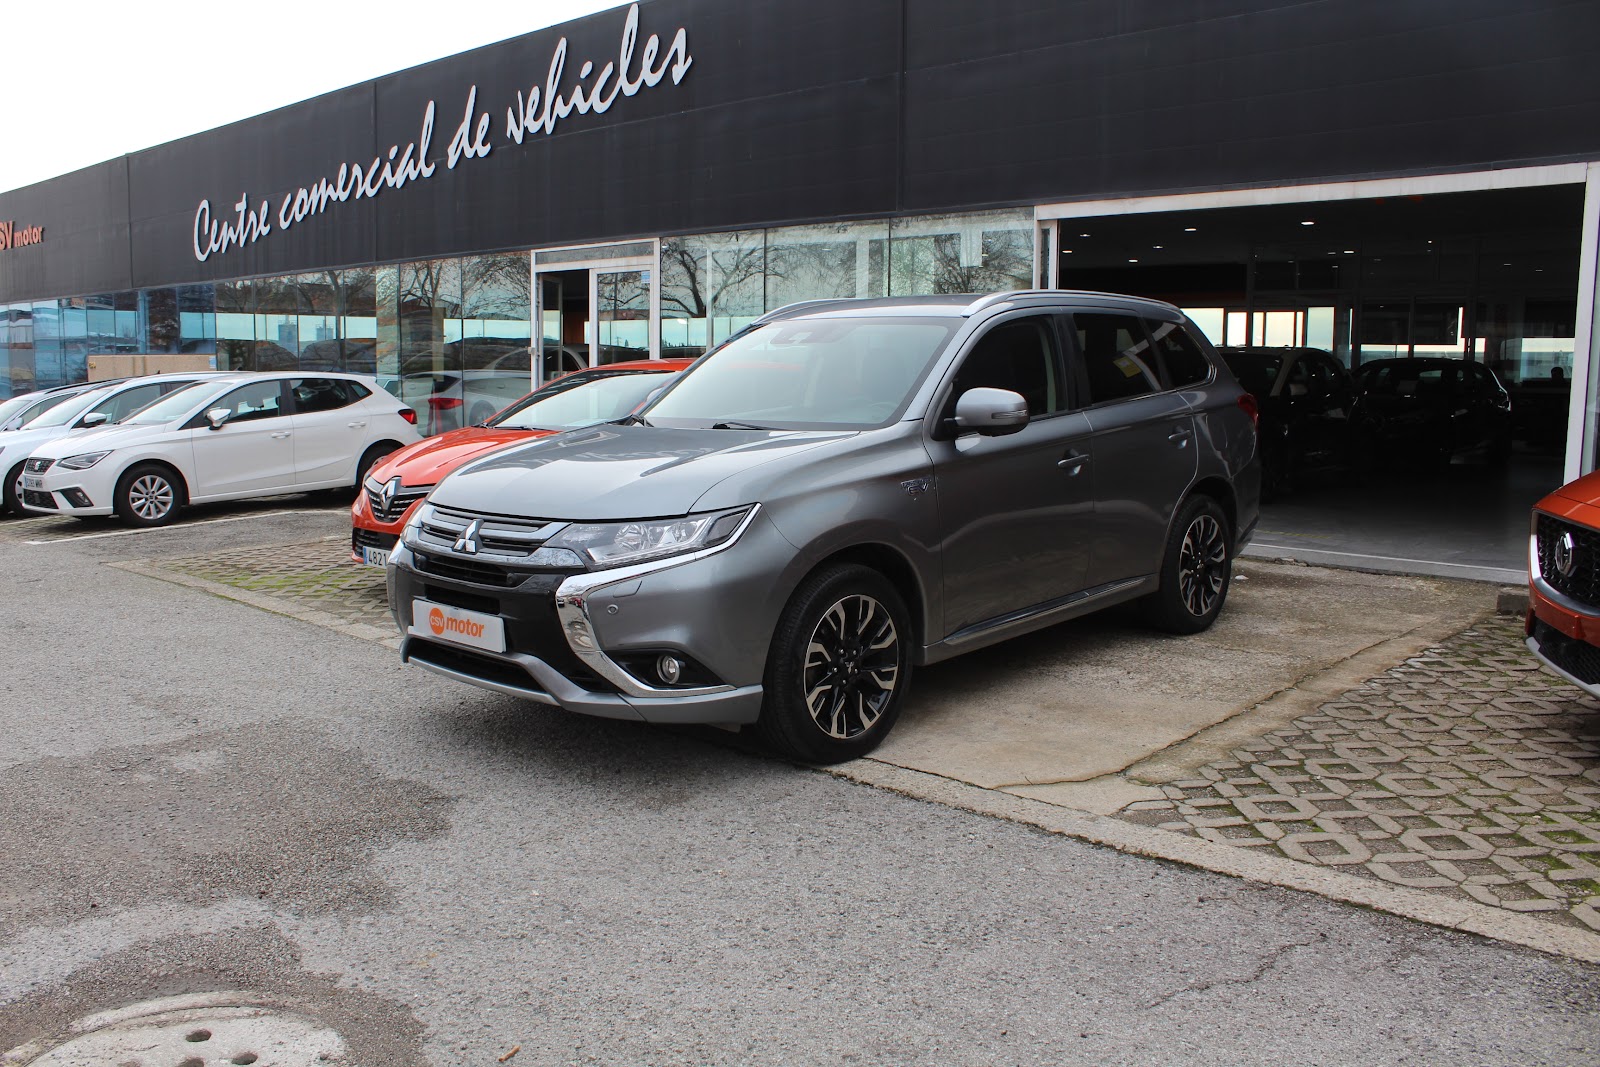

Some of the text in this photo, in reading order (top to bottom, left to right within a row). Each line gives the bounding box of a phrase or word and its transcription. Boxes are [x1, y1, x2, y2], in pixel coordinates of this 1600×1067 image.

[194, 4, 692, 261] Centre comercial de vehicles
[14, 224, 43, 248] motor
[368, 550, 387, 566] 4821
[429, 616, 484, 637] CSV motor
